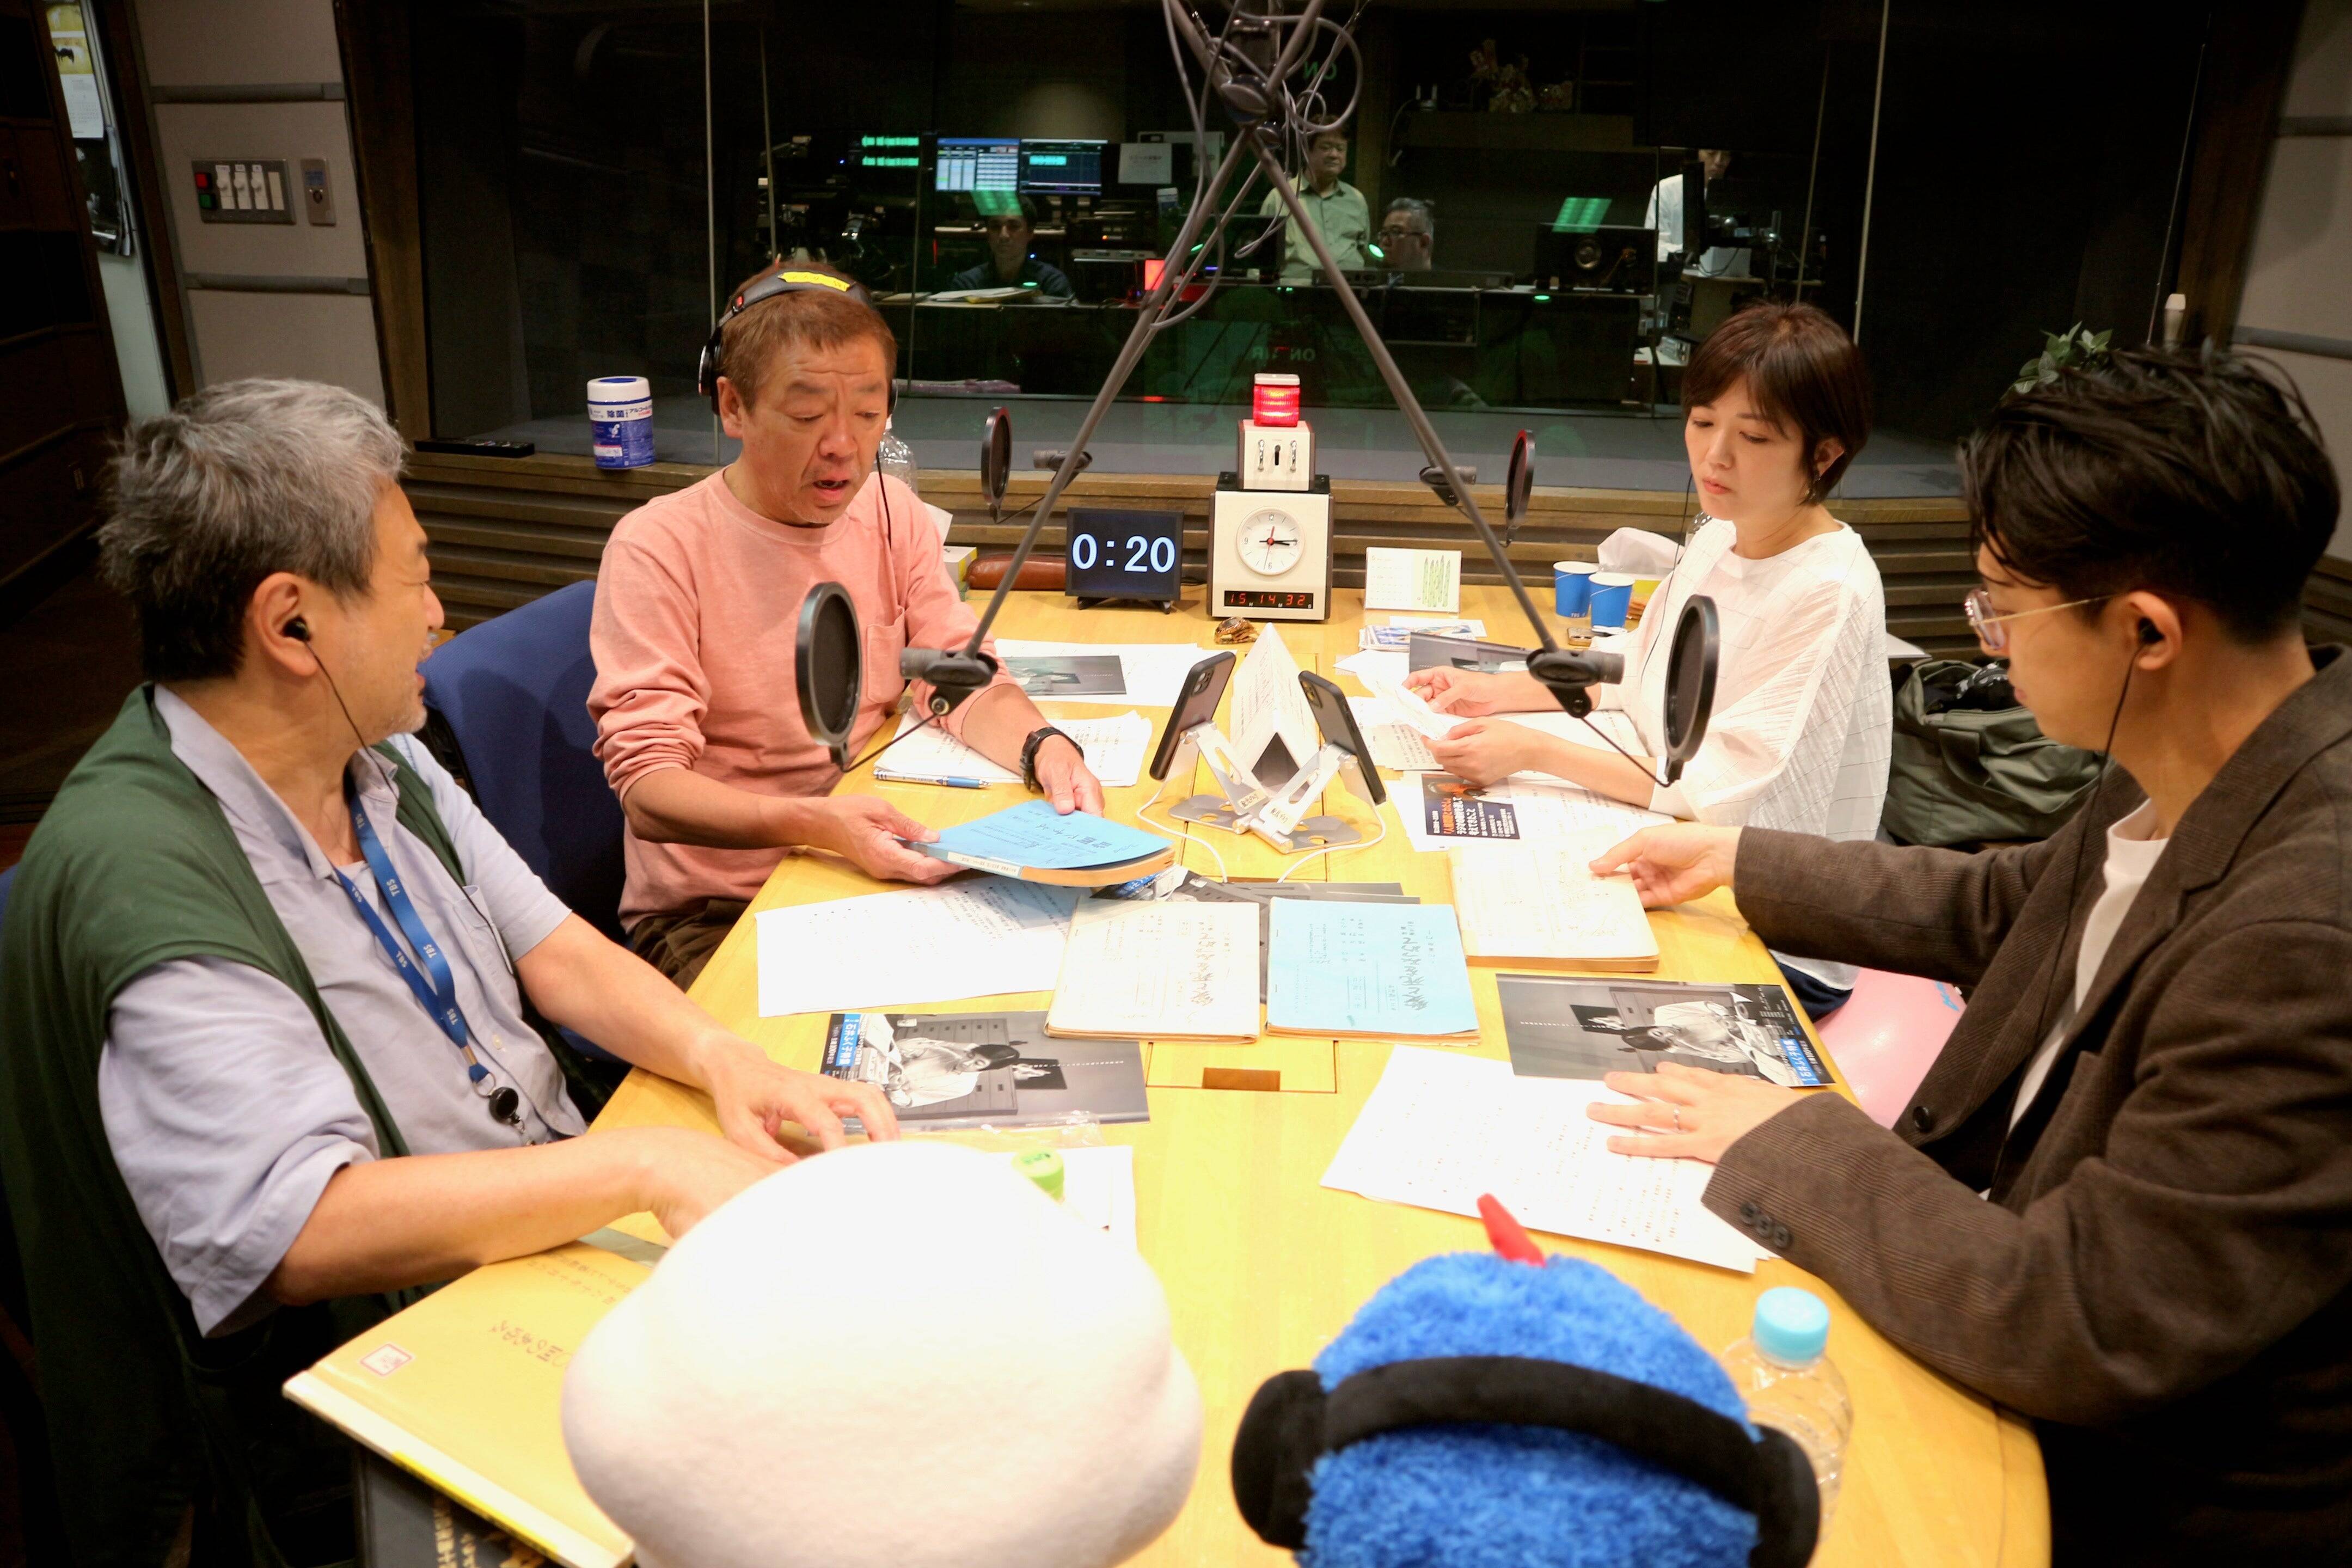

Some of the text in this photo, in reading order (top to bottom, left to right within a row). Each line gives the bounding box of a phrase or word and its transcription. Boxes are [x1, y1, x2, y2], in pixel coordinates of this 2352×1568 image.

[1072, 534, 1175, 573] 0:20
[1230, 593, 1246, 604] 15
[1260, 594, 1276, 604] 14
[1285, 595, 1305, 605] 32
[387, 879, 400, 897] TBS
[396, 950, 408, 968] TBS
[423, 944, 438, 959] TBS
[446, 1008, 458, 1026] TBS
